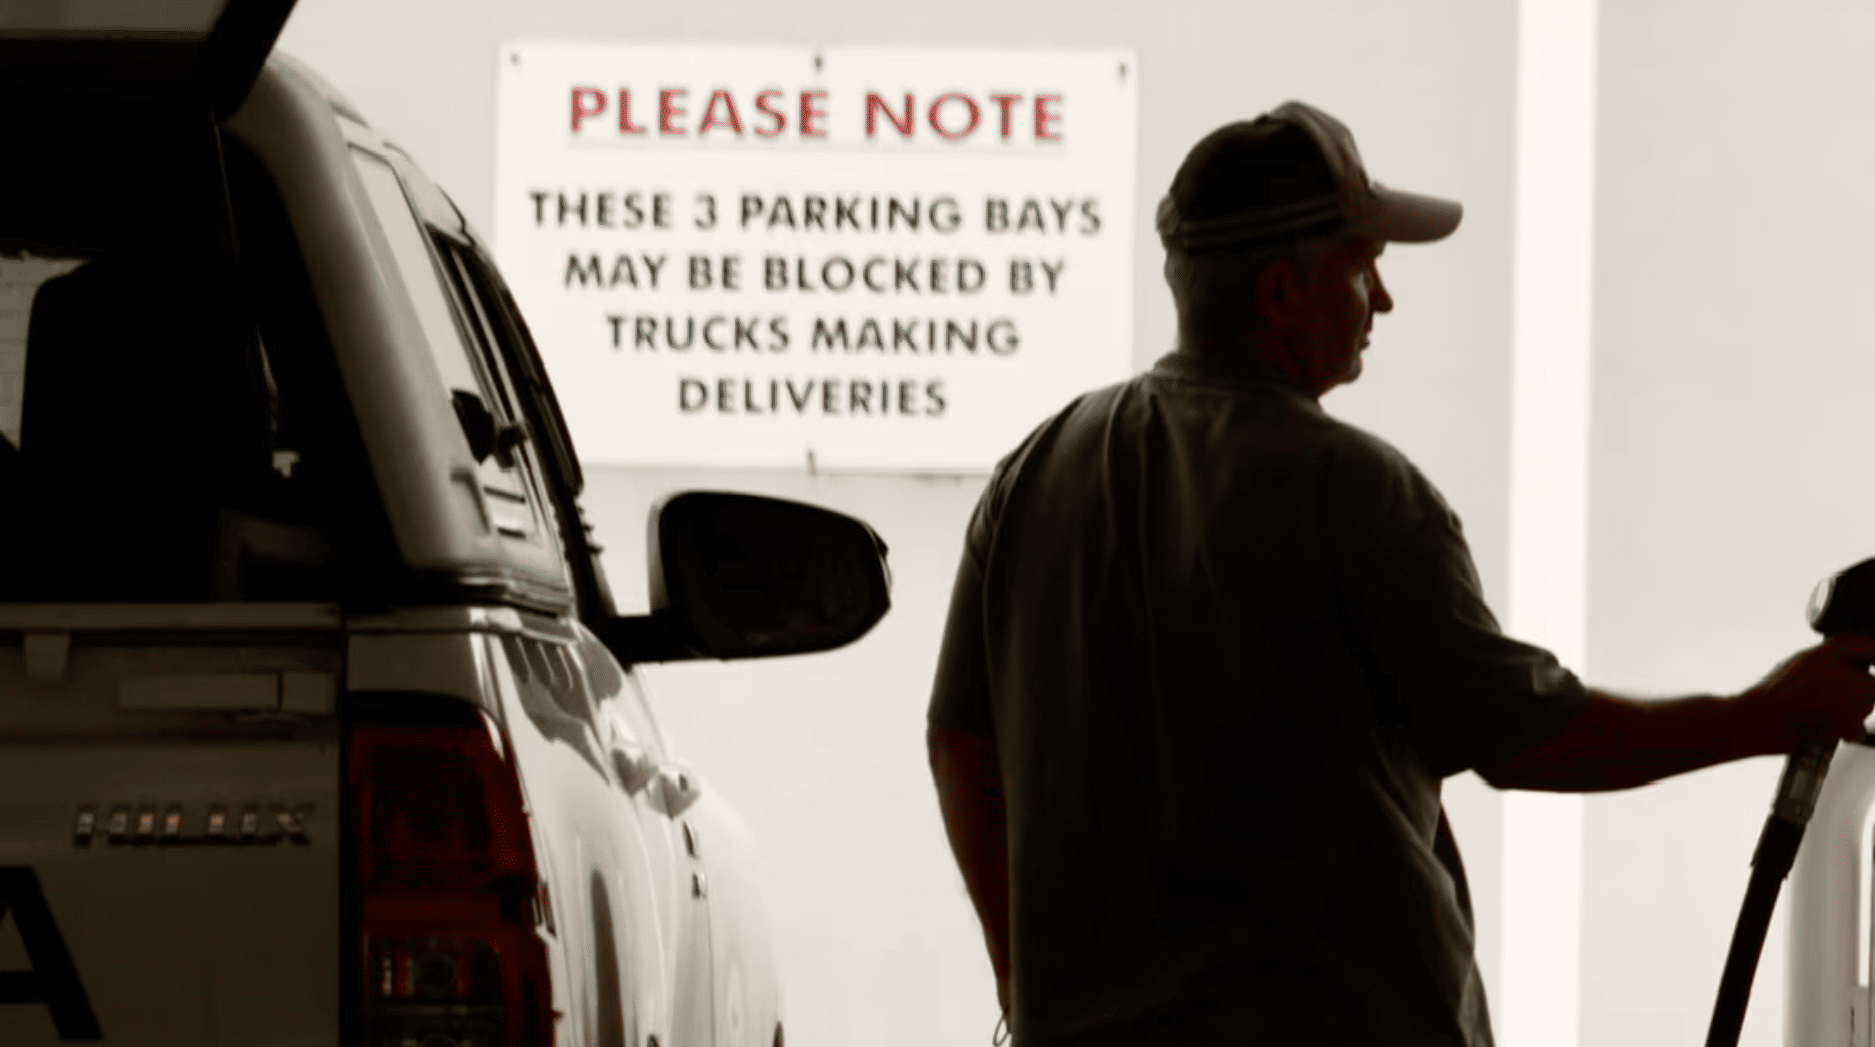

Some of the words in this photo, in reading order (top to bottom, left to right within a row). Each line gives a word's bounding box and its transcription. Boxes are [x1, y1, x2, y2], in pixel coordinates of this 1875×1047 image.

[570, 87, 828, 140] PLEASE
[864, 91, 1061, 142] NOTE
[531, 192, 668, 227] THESE
[694, 194, 717, 230] 3
[741, 195, 961, 232] PARKING
[985, 198, 1101, 234] BAYS
[565, 254, 666, 288] MAY
[689, 256, 737, 289] BE
[764, 257, 986, 293] BLOCKED
[1009, 259, 1063, 294] BY
[607, 315, 790, 352] TRUCKS
[811, 318, 1019, 354] MAKING
[679, 378, 946, 416] DELIVERIES
